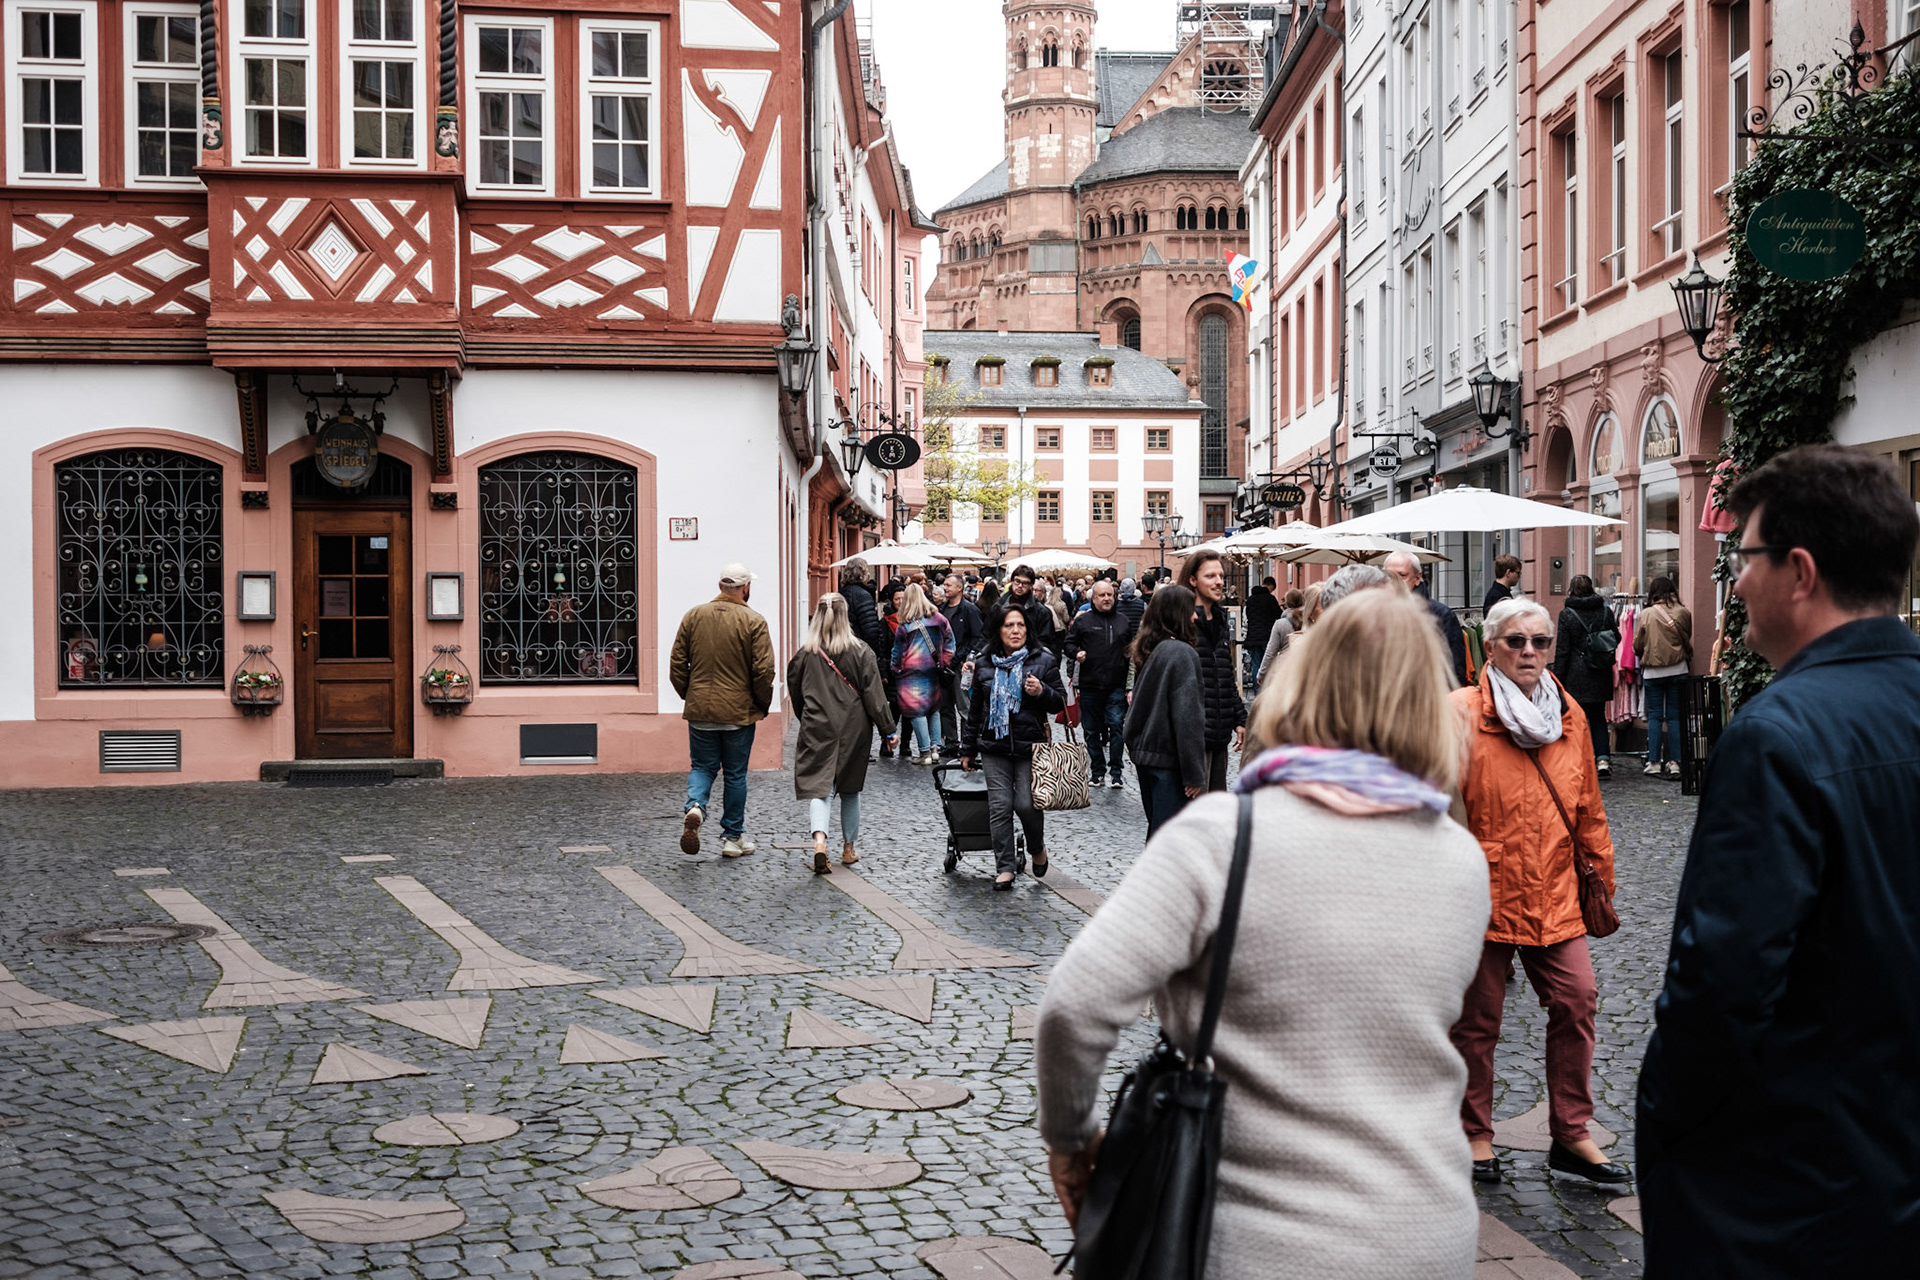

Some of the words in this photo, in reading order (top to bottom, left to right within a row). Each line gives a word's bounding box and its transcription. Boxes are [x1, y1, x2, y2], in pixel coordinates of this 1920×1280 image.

[1758, 212, 1855, 236] Antiquitäten
[1778, 236, 1837, 254] Herber
[326, 438, 368, 448] WEINHAUS
[327, 456, 366, 467] SPIEGEL
[1263, 490, 1303, 502] Willi's
